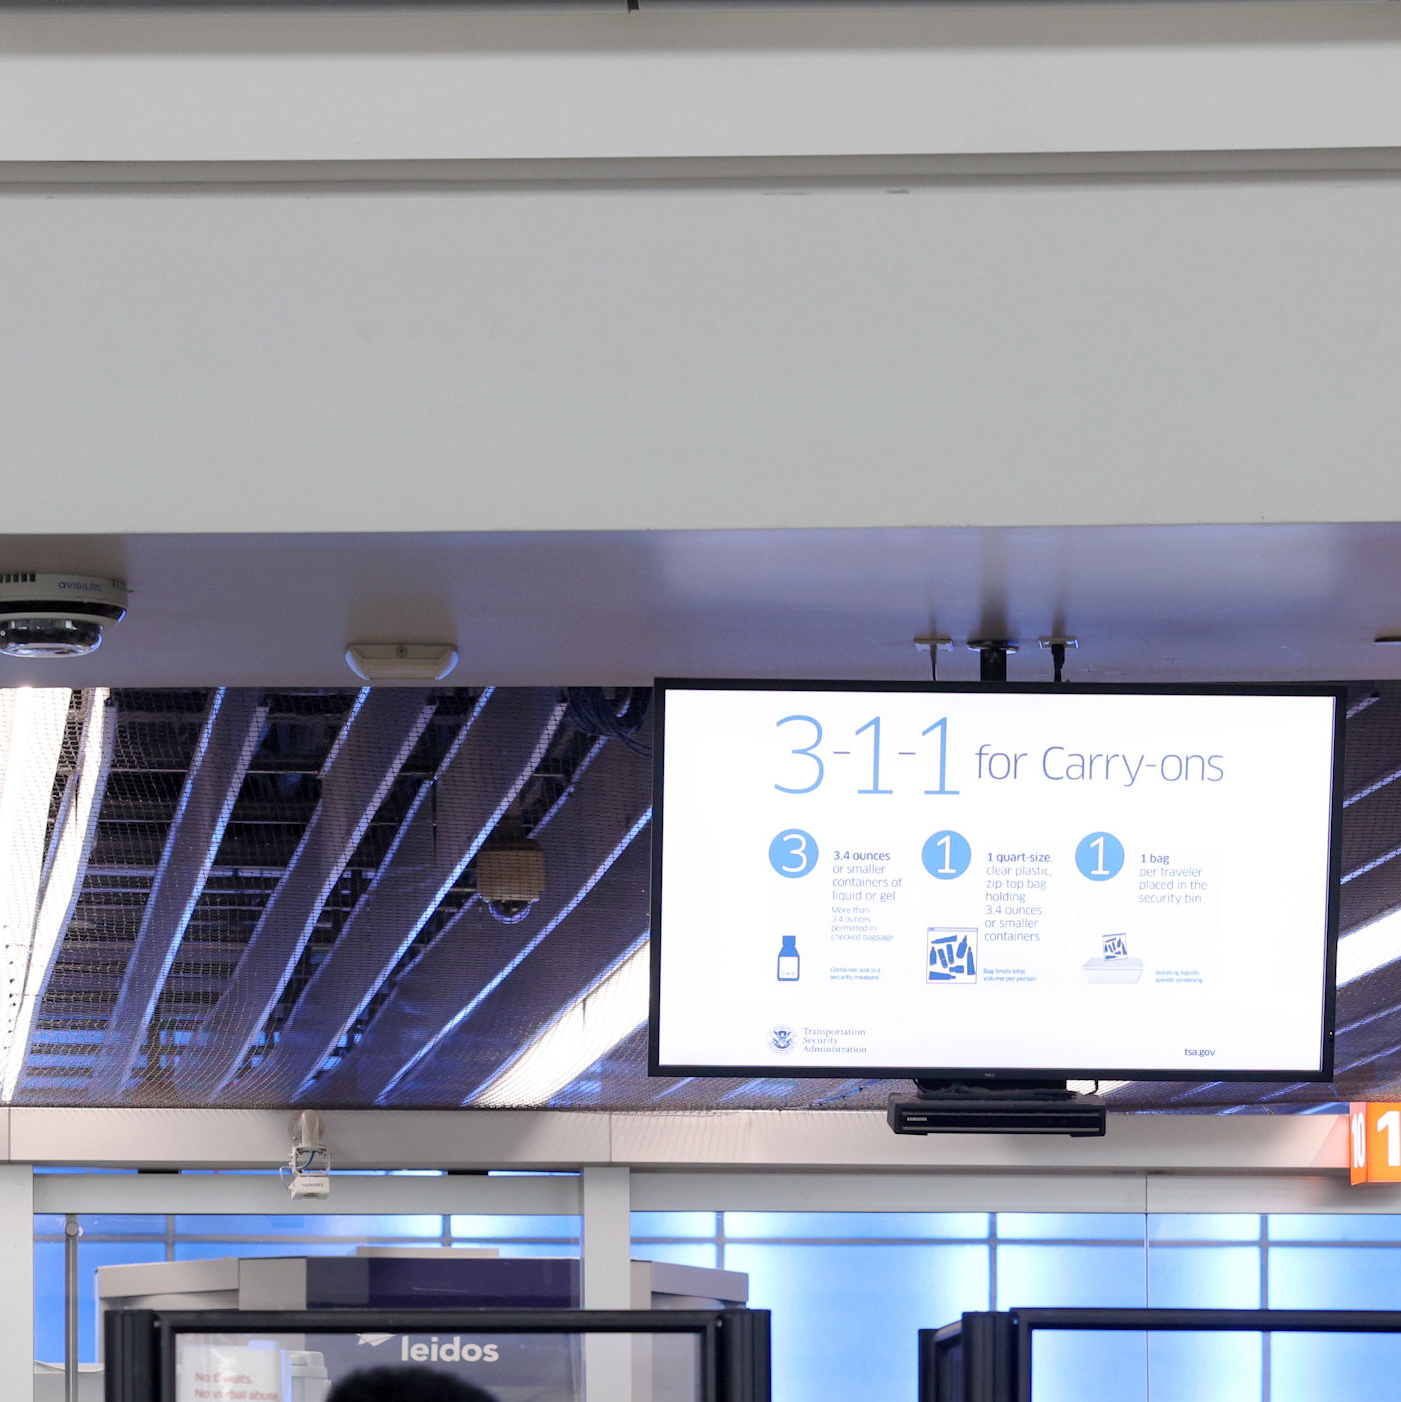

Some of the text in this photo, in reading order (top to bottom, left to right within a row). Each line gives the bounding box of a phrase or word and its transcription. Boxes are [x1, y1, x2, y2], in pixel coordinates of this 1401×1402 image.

[773, 714, 1225, 795] 3-1-1 for Carry-ons
[782, 833, 808, 873] 3
[833, 850, 891, 861] 3.4 ounces
[936, 835, 957, 874] 1
[987, 852, 993, 862] 1
[1089, 836, 1110, 875] 1
[1141, 853, 1170, 865] 1 bag
[832, 864, 886, 874] or smaller
[986, 865, 1053, 877] clear plastic,
[1139, 867, 1203, 878] per traveler
[832, 877, 902, 888] containers of
[1027, 879, 1047, 890] bag
[1139, 880, 1208, 891] placed in the
[832, 890, 896, 903] liquid or gel
[985, 892, 1026, 903] holding
[1138, 893, 1202, 905] security bin
[1005, 906, 1043, 915] ounces
[984, 918, 1039, 928] or smaller
[984, 931, 1041, 942] containers
[803, 1027, 866, 1037] Transportation
[803, 1037, 838, 1045] Security
[803, 1045, 867, 1053] Administration
[1184, 1048, 1216, 1058] tsa.gov
[1351, 1112, 1366, 1169] 10
[401, 1335, 500, 1363] leidos
